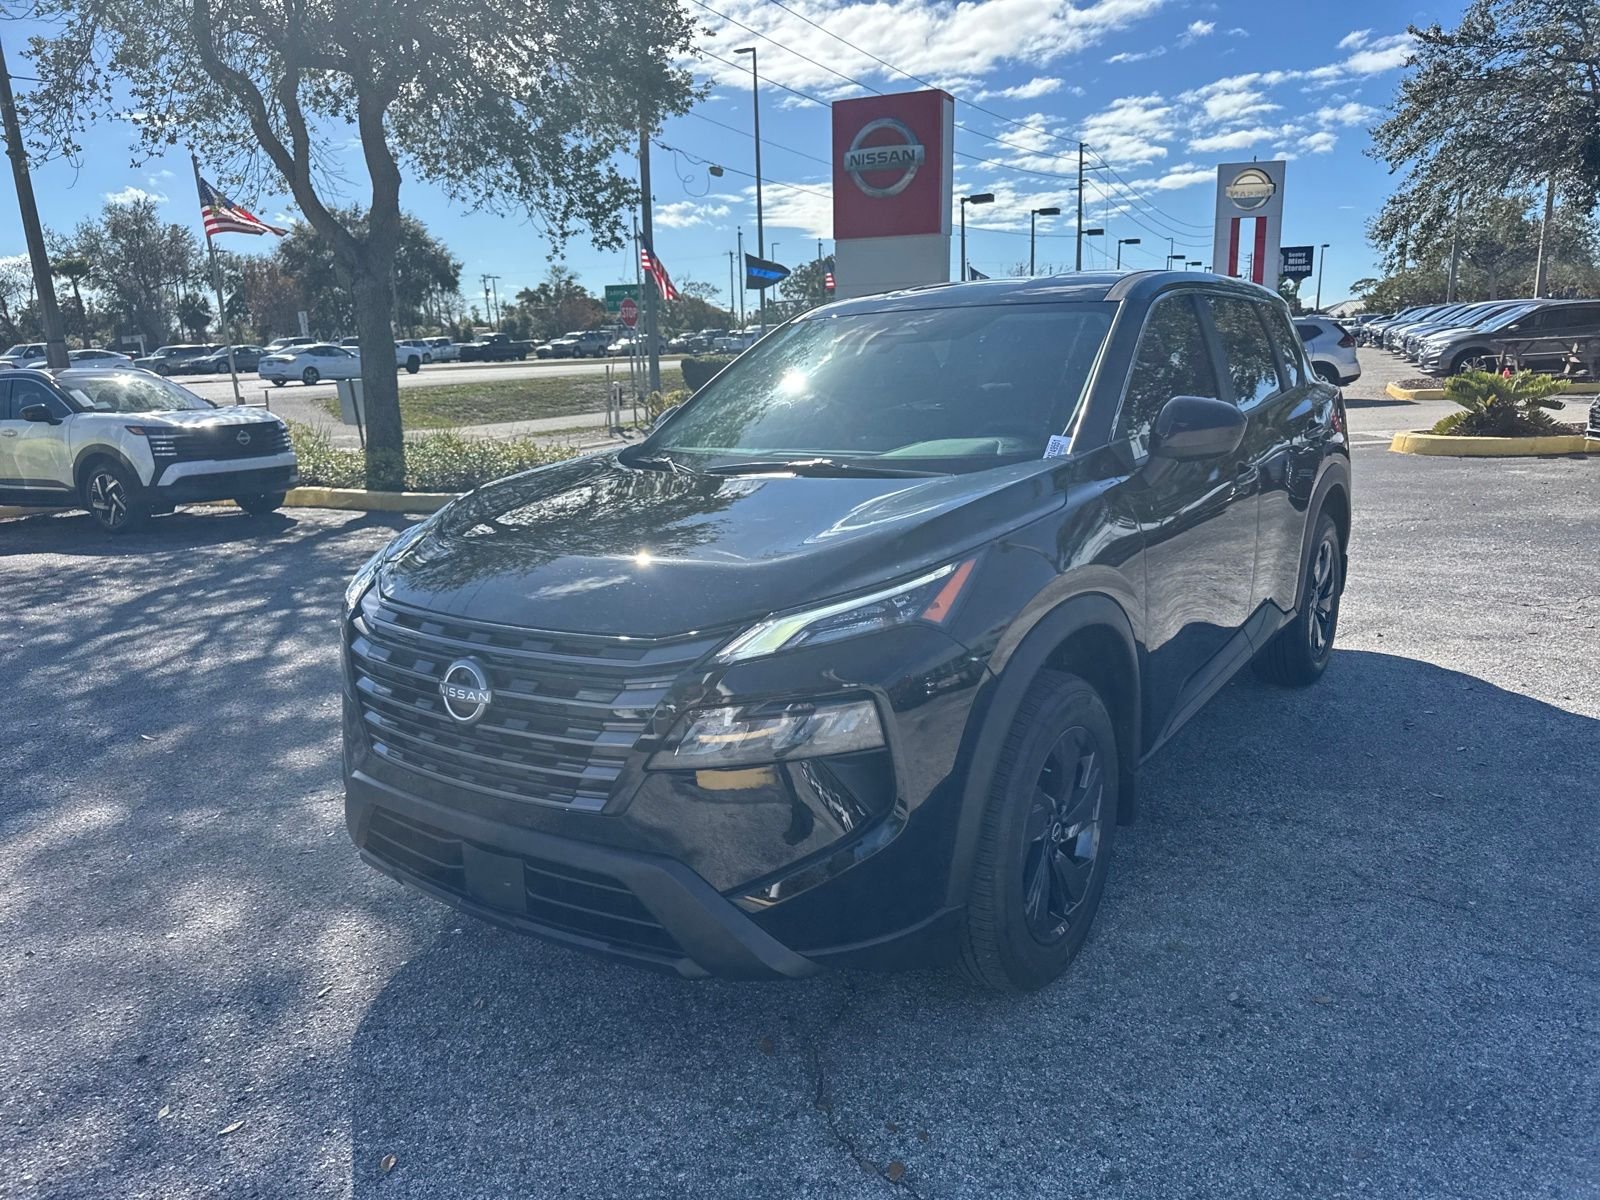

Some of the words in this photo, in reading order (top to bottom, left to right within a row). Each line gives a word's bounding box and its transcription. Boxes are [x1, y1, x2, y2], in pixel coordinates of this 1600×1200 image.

[850, 149, 915, 167] NISSAN
[621, 307, 637, 319] STOP
[440, 683, 489, 702] NISSAN
